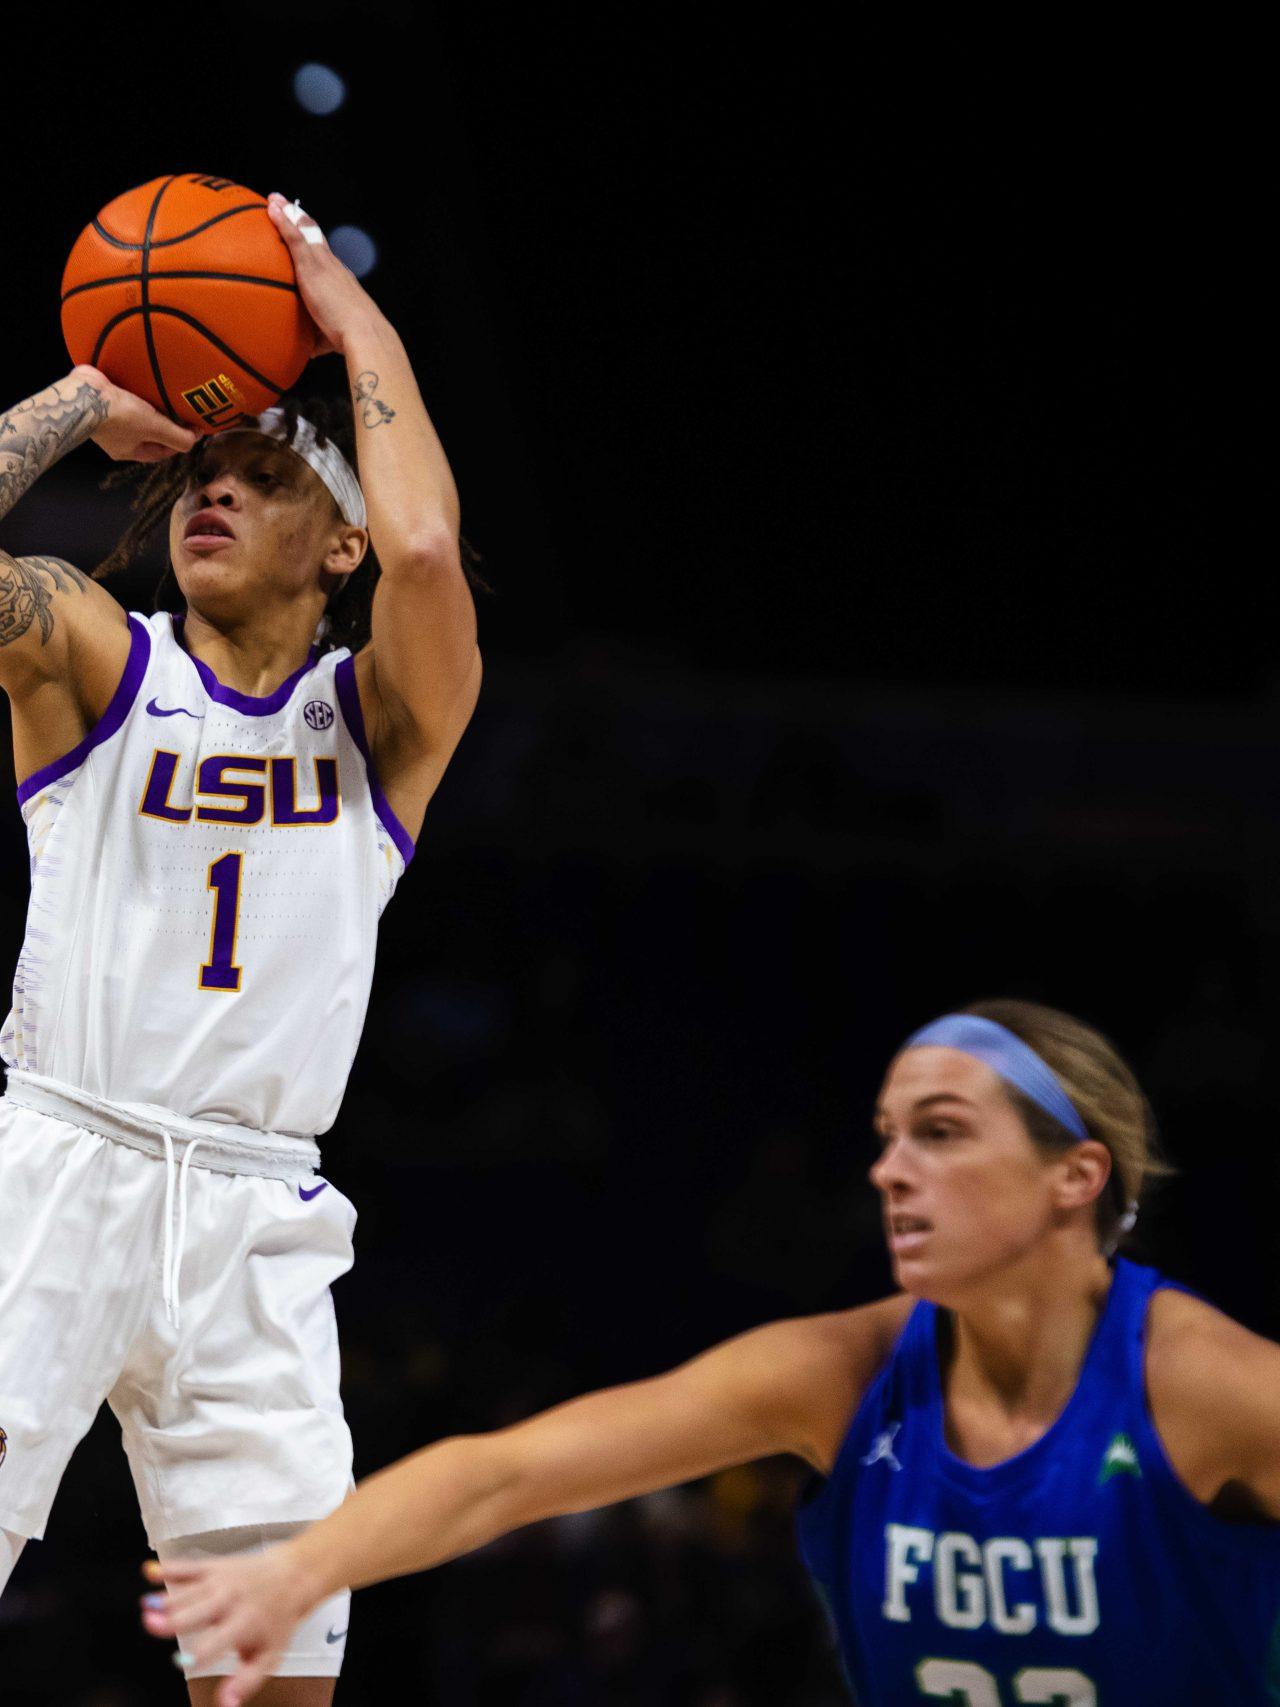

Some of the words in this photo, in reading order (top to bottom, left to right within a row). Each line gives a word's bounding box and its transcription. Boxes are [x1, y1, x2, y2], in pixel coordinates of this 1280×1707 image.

[304, 701, 334, 730] SEC
[138, 749, 342, 827] LSU
[198, 850, 243, 992] 1
[882, 1522, 1100, 1636] FGCU
